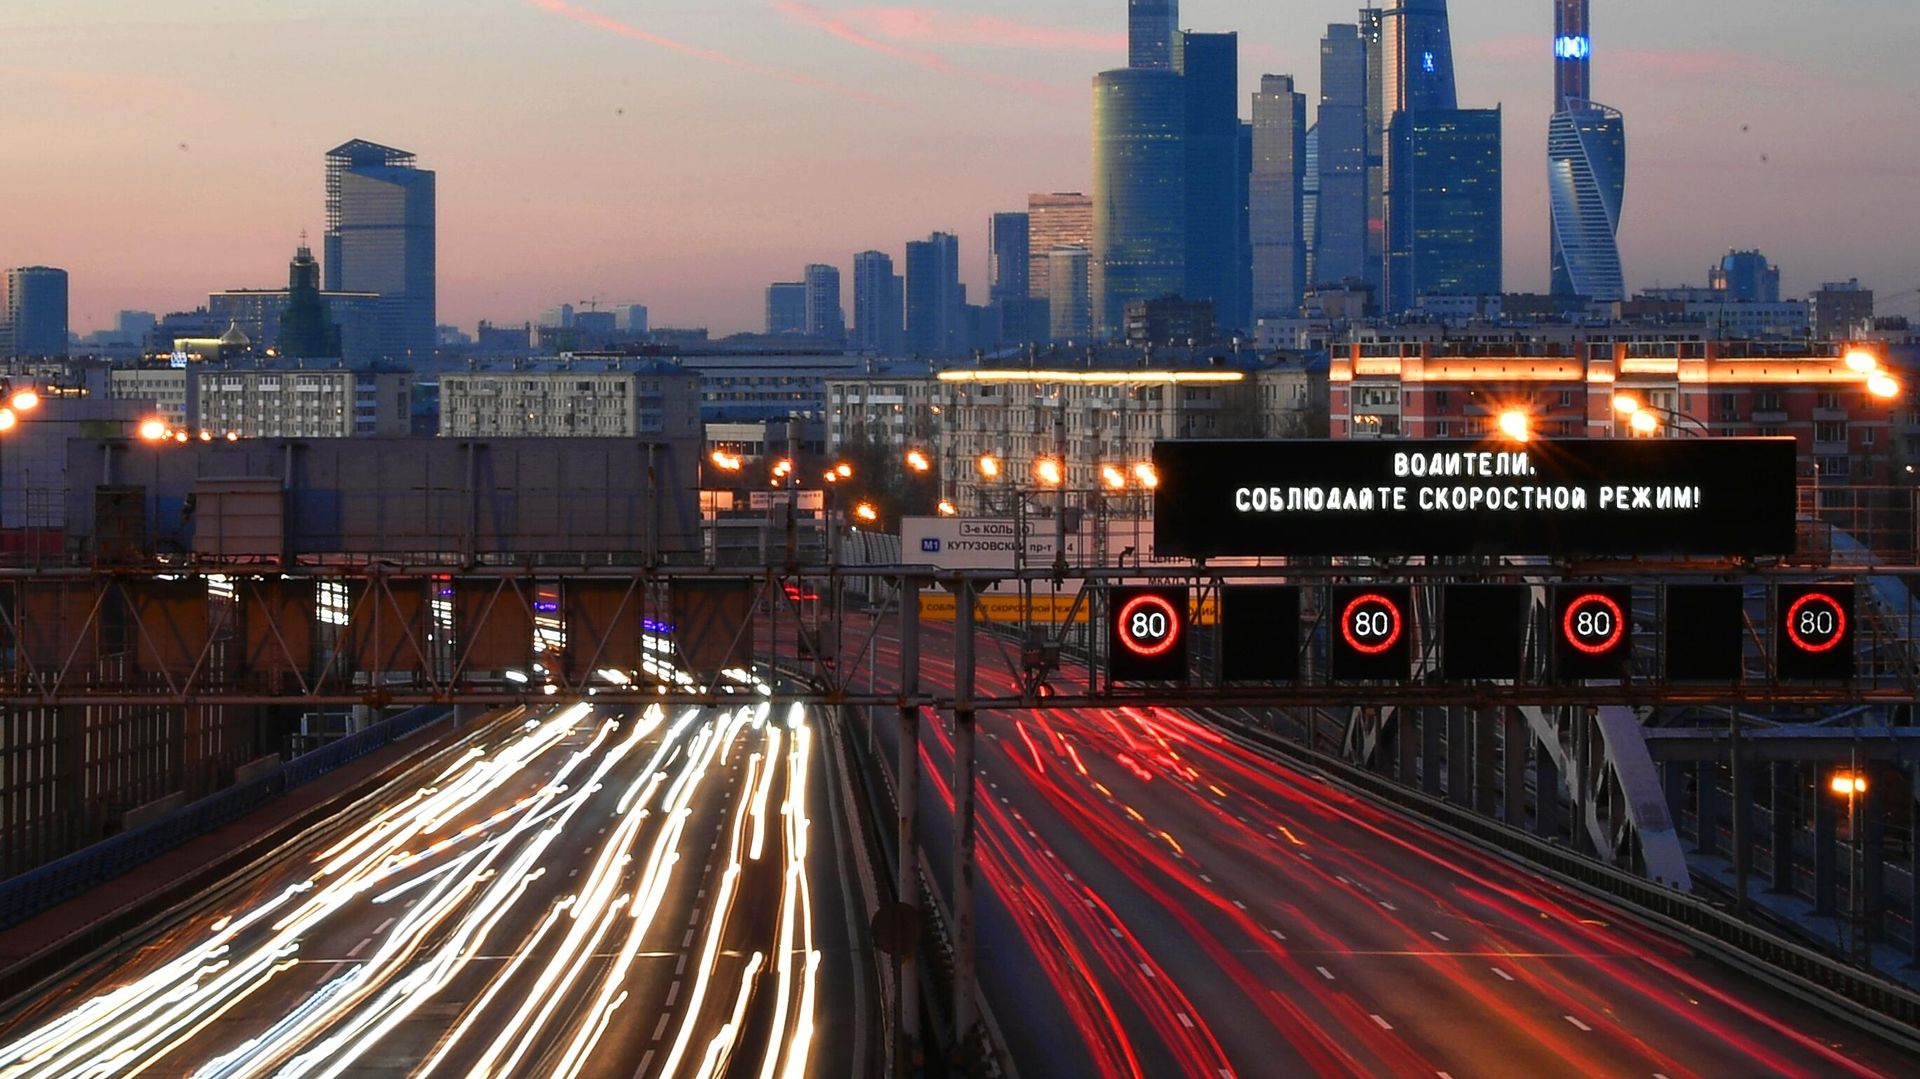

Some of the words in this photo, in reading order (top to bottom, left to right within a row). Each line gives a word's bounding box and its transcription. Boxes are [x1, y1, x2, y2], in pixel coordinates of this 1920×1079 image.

[1236, 487, 1406, 511] СОБЛЮДАЙТЕ
[1420, 487, 1586, 510] СКОРОСТНОЙ
[1600, 486, 1701, 509] РЕЖИМ!
[983, 524, 1030, 534] КОЛЬО
[1132, 612, 1166, 638] 80
[1355, 611, 1388, 636] 80
[1577, 611, 1610, 636] 80
[1800, 610, 1833, 635] 80
